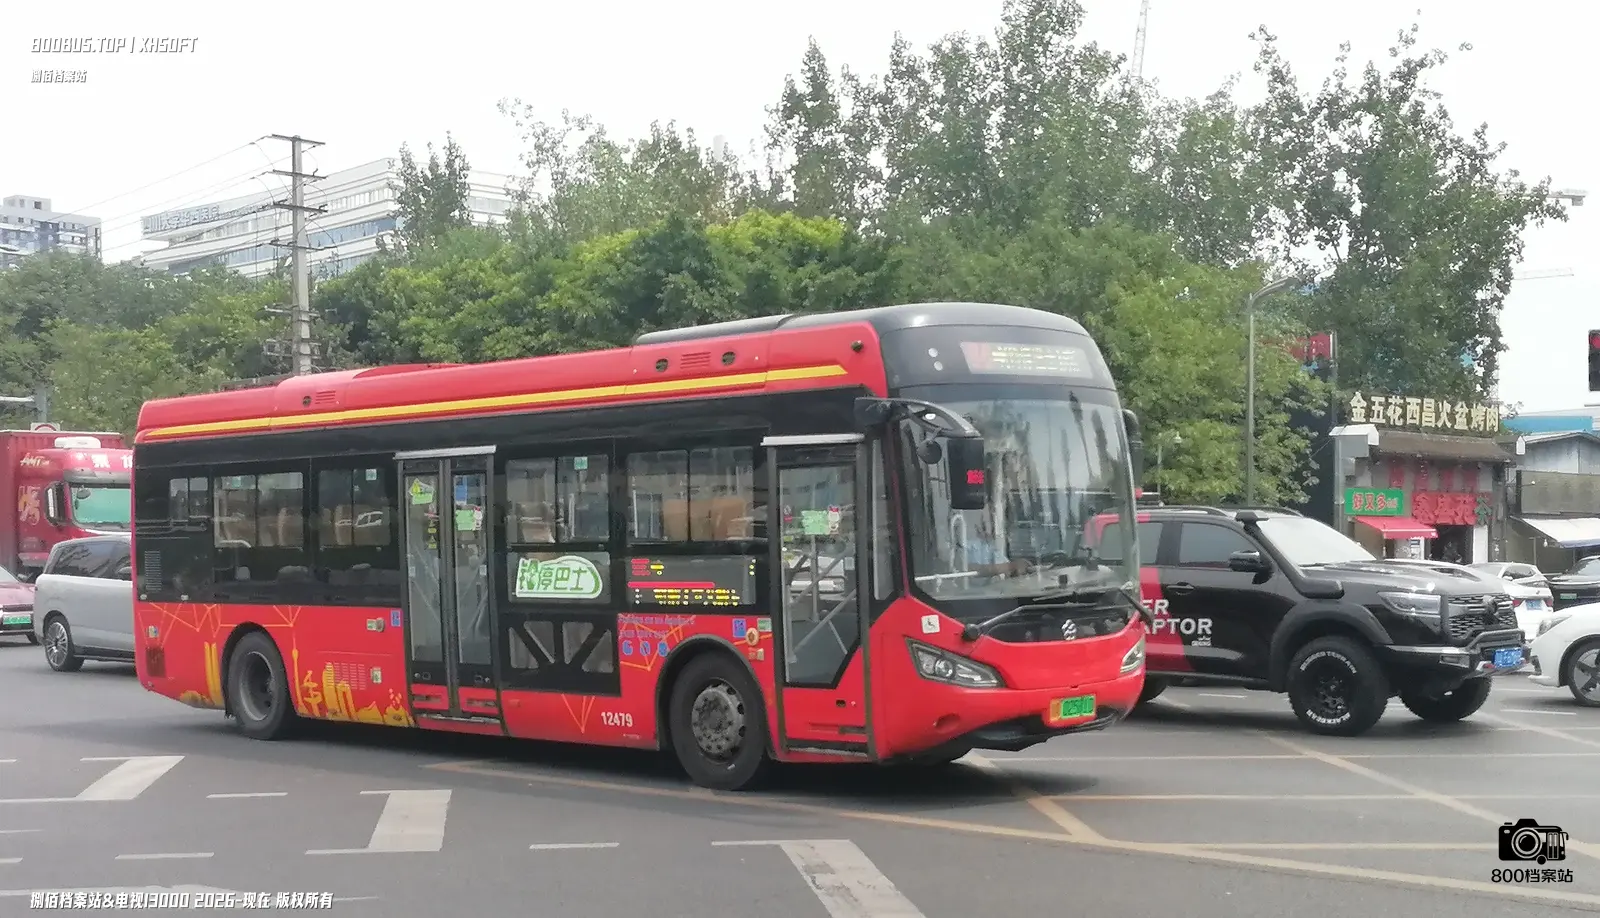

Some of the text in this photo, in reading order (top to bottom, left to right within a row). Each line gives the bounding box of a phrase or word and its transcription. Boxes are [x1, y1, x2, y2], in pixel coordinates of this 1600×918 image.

[1350, 391, 1500, 432] 金五花西昌火盆烤肉
[1352, 492, 1388, 511] 好又多
[600, 711, 633, 728] 12479
